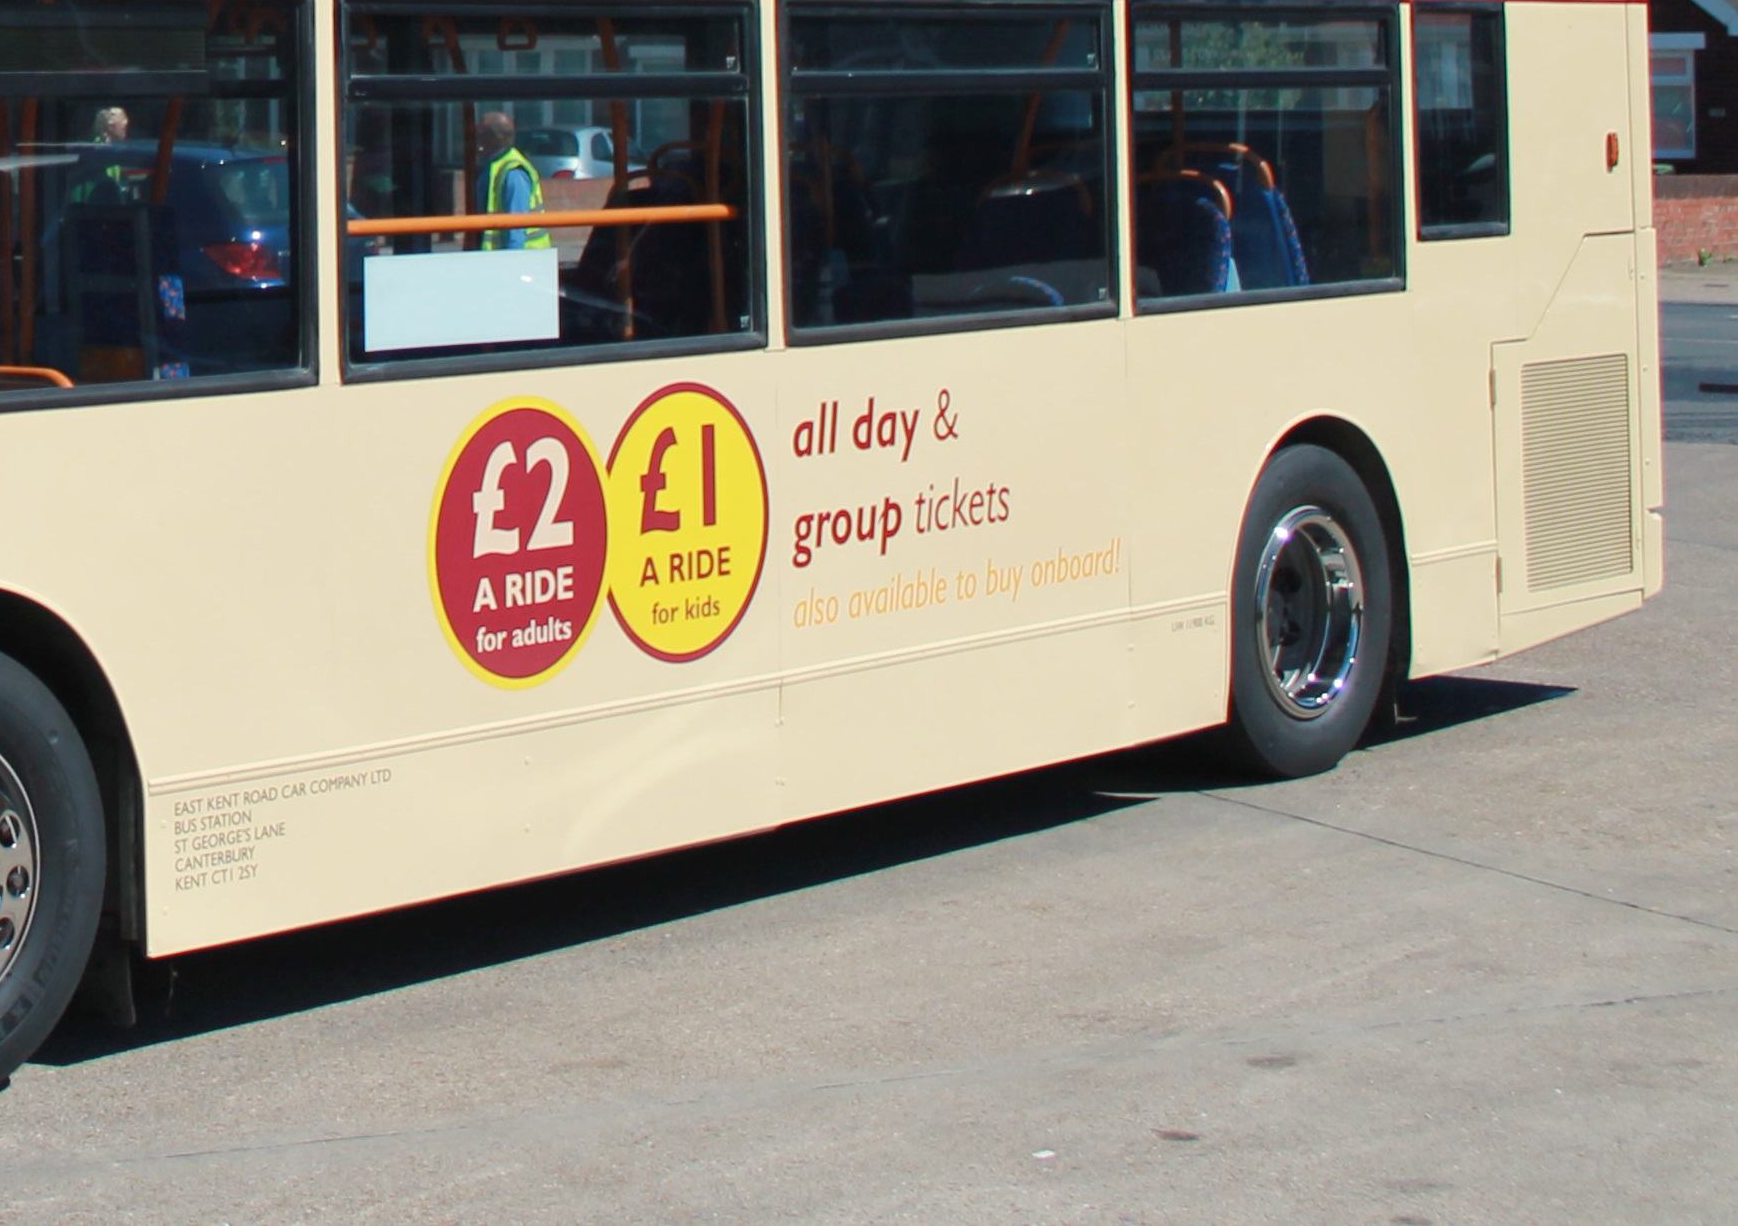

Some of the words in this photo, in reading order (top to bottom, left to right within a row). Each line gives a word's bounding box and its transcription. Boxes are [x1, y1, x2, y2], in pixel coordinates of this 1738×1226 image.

[792, 400, 839, 458] all
[852, 397, 920, 462] day
[933, 388, 959, 442] &
[472, 436, 574, 559] £2
[640, 424, 716, 535] £1
[792, 496, 902, 569] group
[914, 477, 1010, 534] tickets
[640, 557, 659, 587] A
[669, 546, 731, 583] RIDE
[793, 587, 838, 628] also
[848, 567, 947, 619] available
[955, 571, 977, 601] to
[985, 559, 1024, 603] buy
[1030, 537, 1121, 588] onboard!
[473, 577, 497, 612] A
[505, 566, 574, 608] RIDE
[653, 601, 678, 625] for
[684, 595, 720, 621] kids
[476, 626, 507, 653] for
[511, 617, 572, 648] adults
[174, 799, 203, 817] EAST
[207, 792, 240, 811] KENT
[243, 786, 278, 805] ROAD
[281, 782, 307, 799] CAR
[310, 773, 368, 795] COMPANY
[370, 769, 392, 785] LTD
[174, 818, 197, 835] BUS
[200, 810, 252, 831] STATION
[174, 838, 188, 854] ST
[254, 822, 286, 840] LANE
[175, 845, 256, 872] CANTERBURY
[175, 872, 208, 891] KENT
